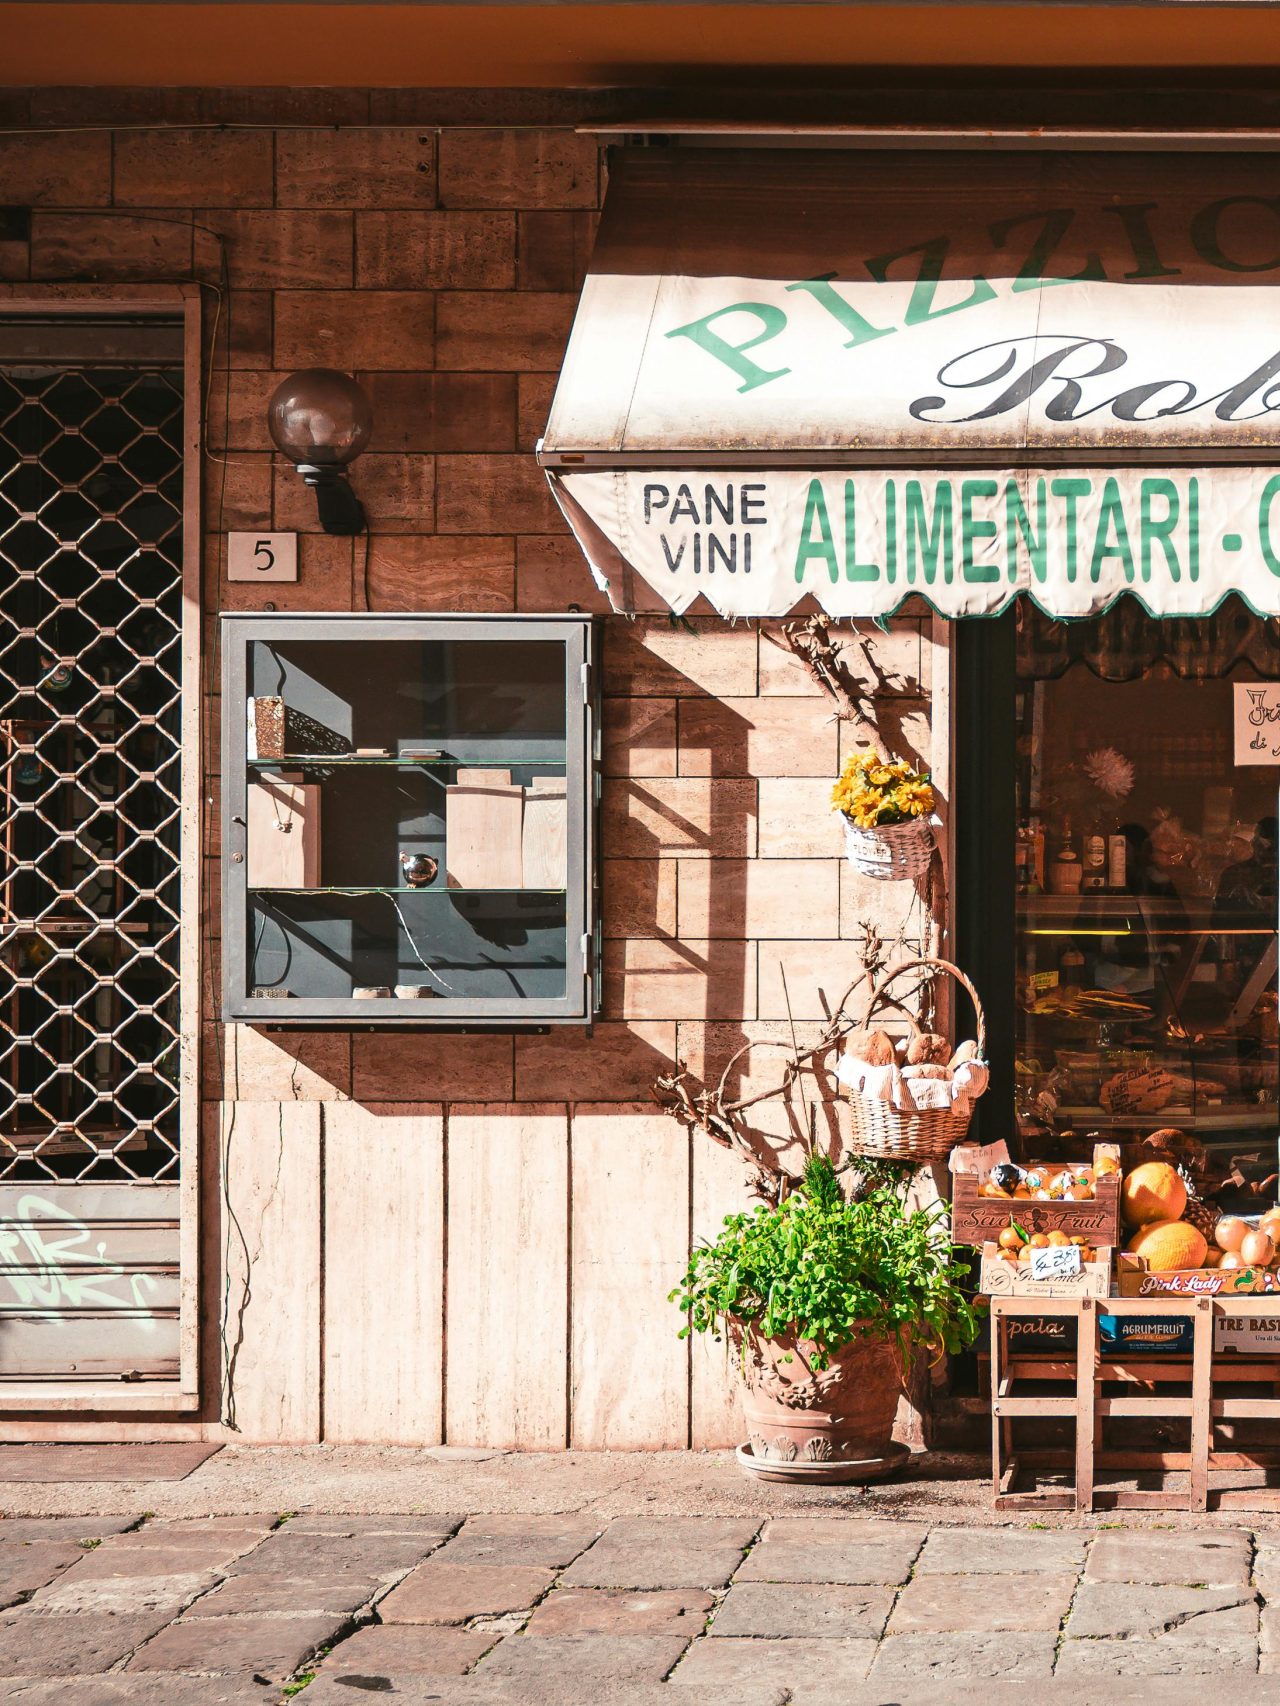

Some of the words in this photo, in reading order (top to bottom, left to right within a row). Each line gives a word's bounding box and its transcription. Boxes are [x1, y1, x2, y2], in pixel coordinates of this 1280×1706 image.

[643, 484, 768, 526] PANE
[794, 478, 1200, 584] ALIMENTARI
[253, 540, 275, 571] 5
[660, 533, 752, 574] VINI
[1249, 731, 1267, 750] di
[1054, 1211, 1108, 1229] Fruit
[1139, 1276, 1181, 1295] Pink
[1182, 1275, 1222, 1295] Lady
[1218, 1318, 1244, 1331] TRE
